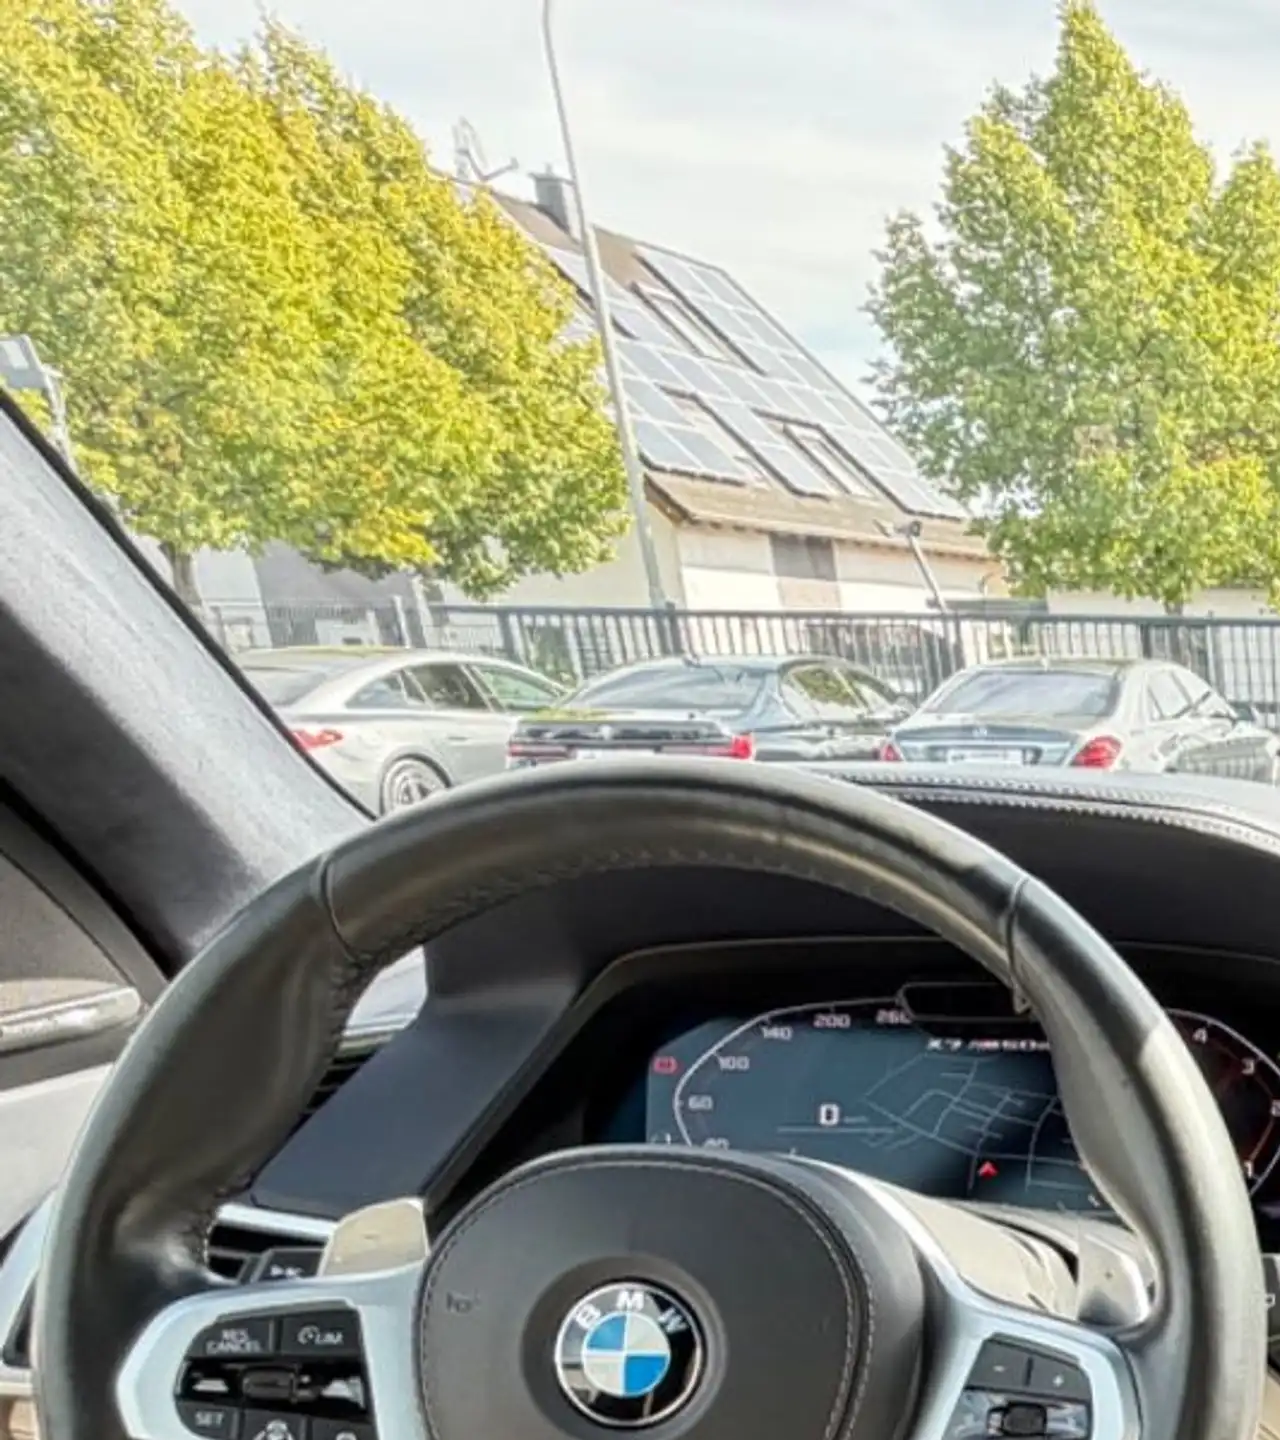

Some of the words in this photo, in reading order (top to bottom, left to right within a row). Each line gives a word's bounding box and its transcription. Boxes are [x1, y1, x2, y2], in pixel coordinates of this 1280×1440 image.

[814, 1014, 850, 1028] 200
[761, 1026, 794, 1041] 140
[1193, 1028, 1208, 1044] 4
[719, 1056, 750, 1071] 100
[1241, 1058, 1255, 1075] 3
[688, 1096, 713, 1110] 60
[574, 1290, 690, 1335] BMW
[205, 1340, 263, 1354] CANCEL
[195, 1411, 224, 1426] SET
